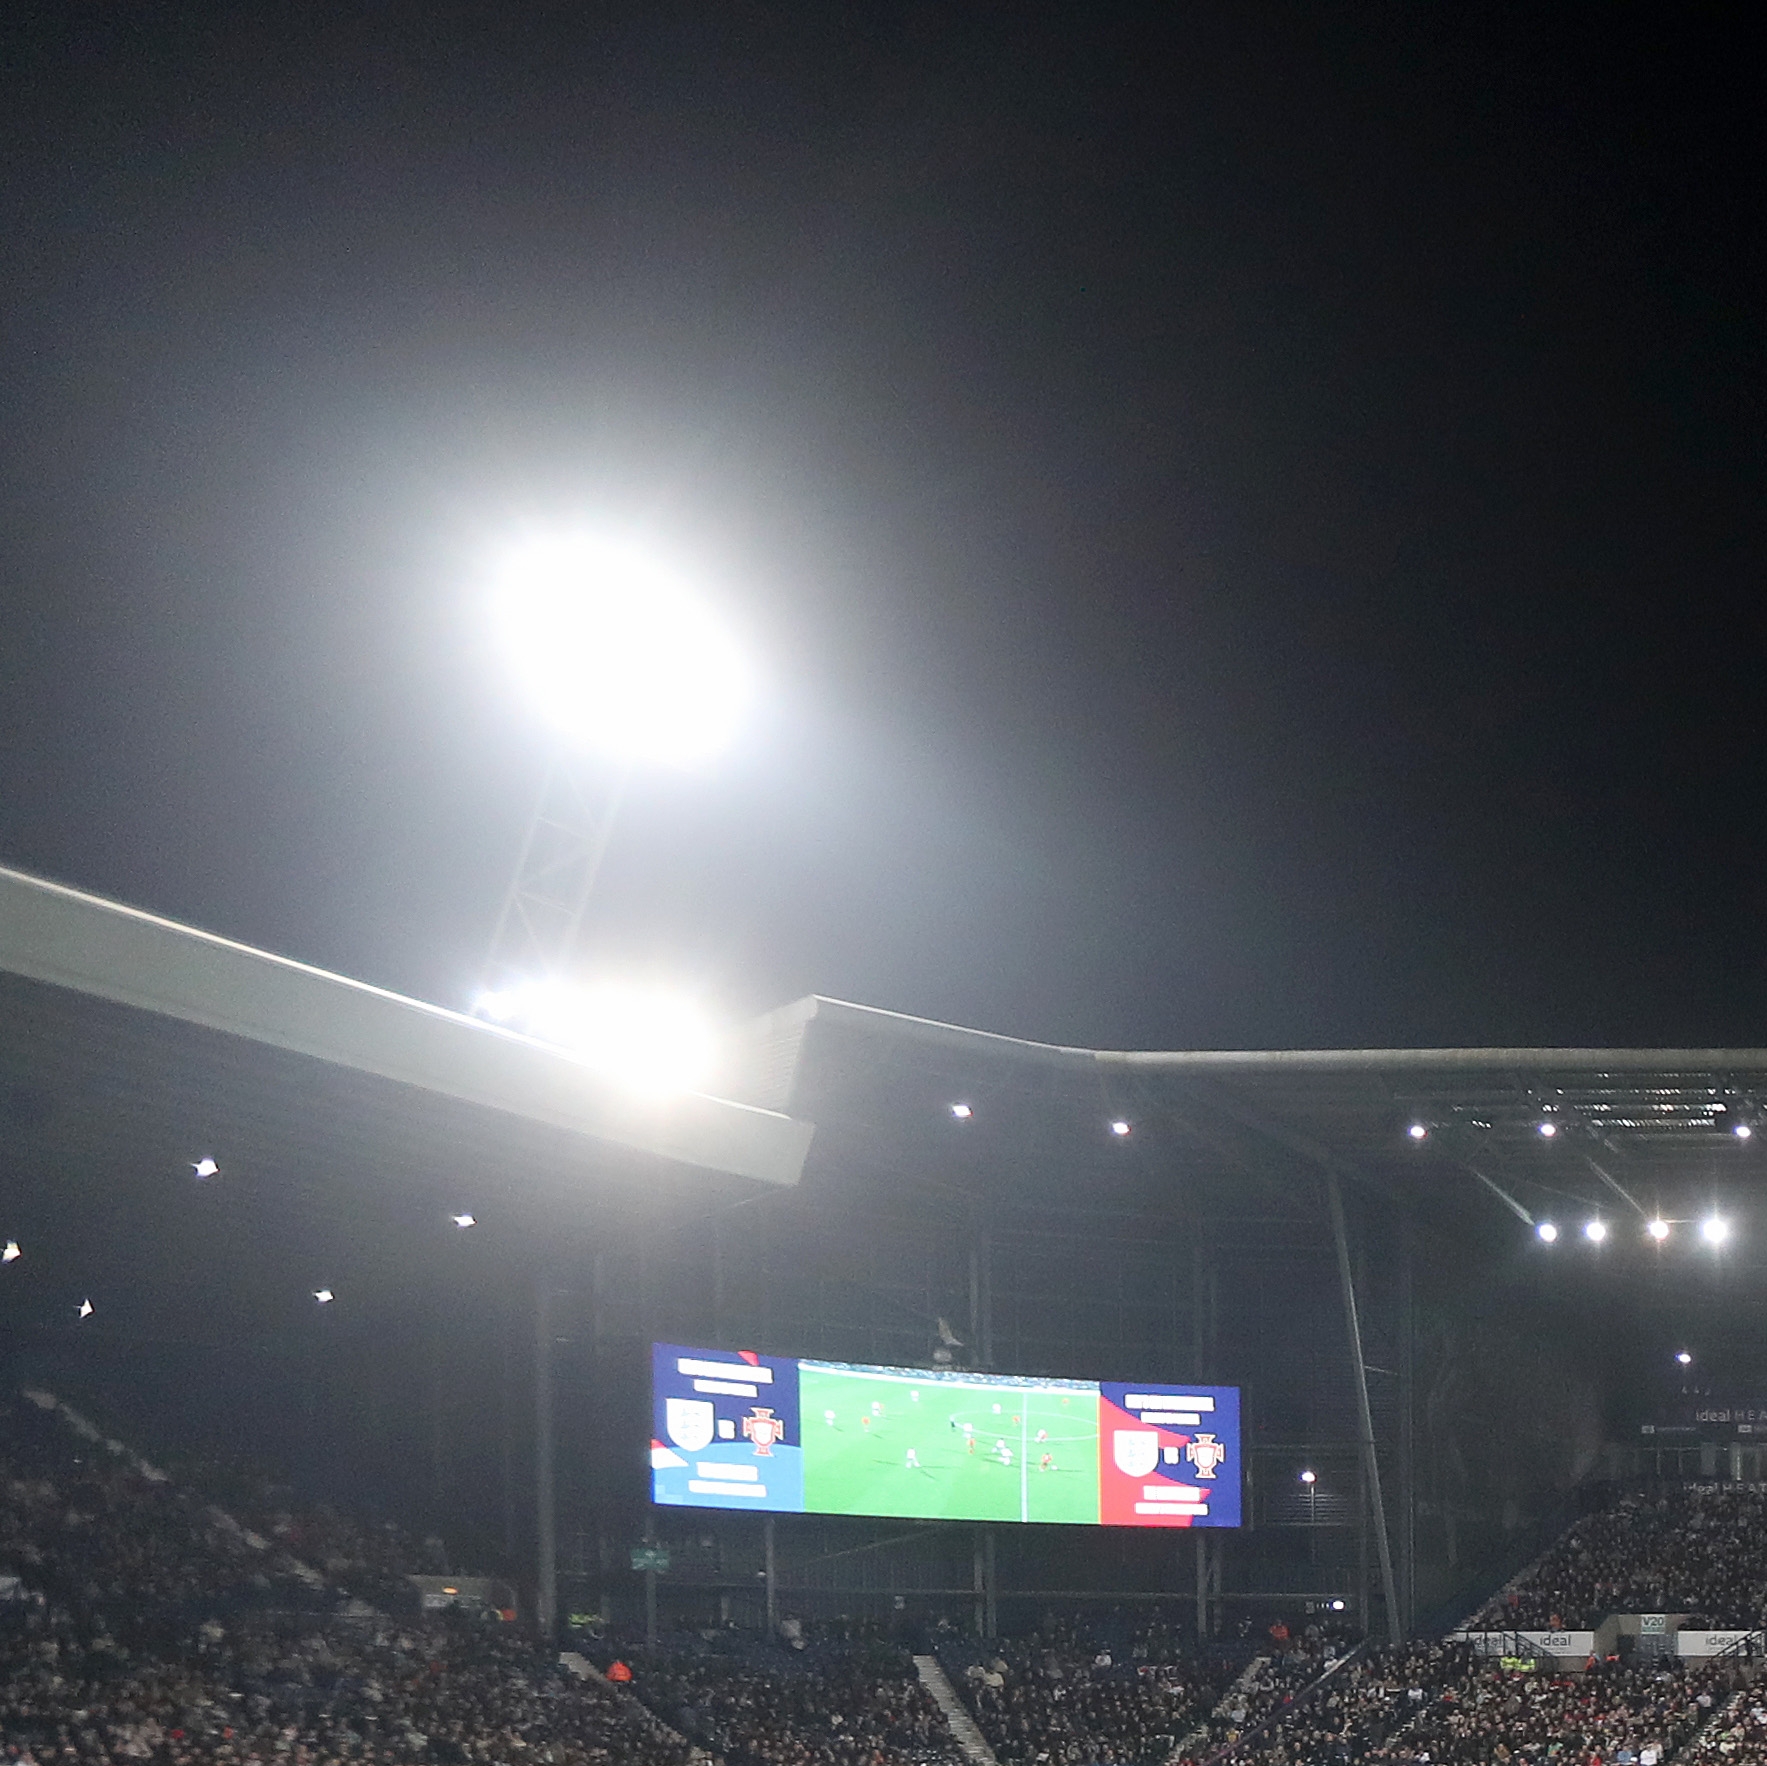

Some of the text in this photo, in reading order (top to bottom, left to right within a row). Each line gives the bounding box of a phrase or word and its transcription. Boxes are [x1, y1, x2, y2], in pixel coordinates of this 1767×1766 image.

[1696, 1409, 1730, 1422] ideal
[1643, 1616, 1664, 1626] V20
[1539, 1635, 1571, 1647] ideal
